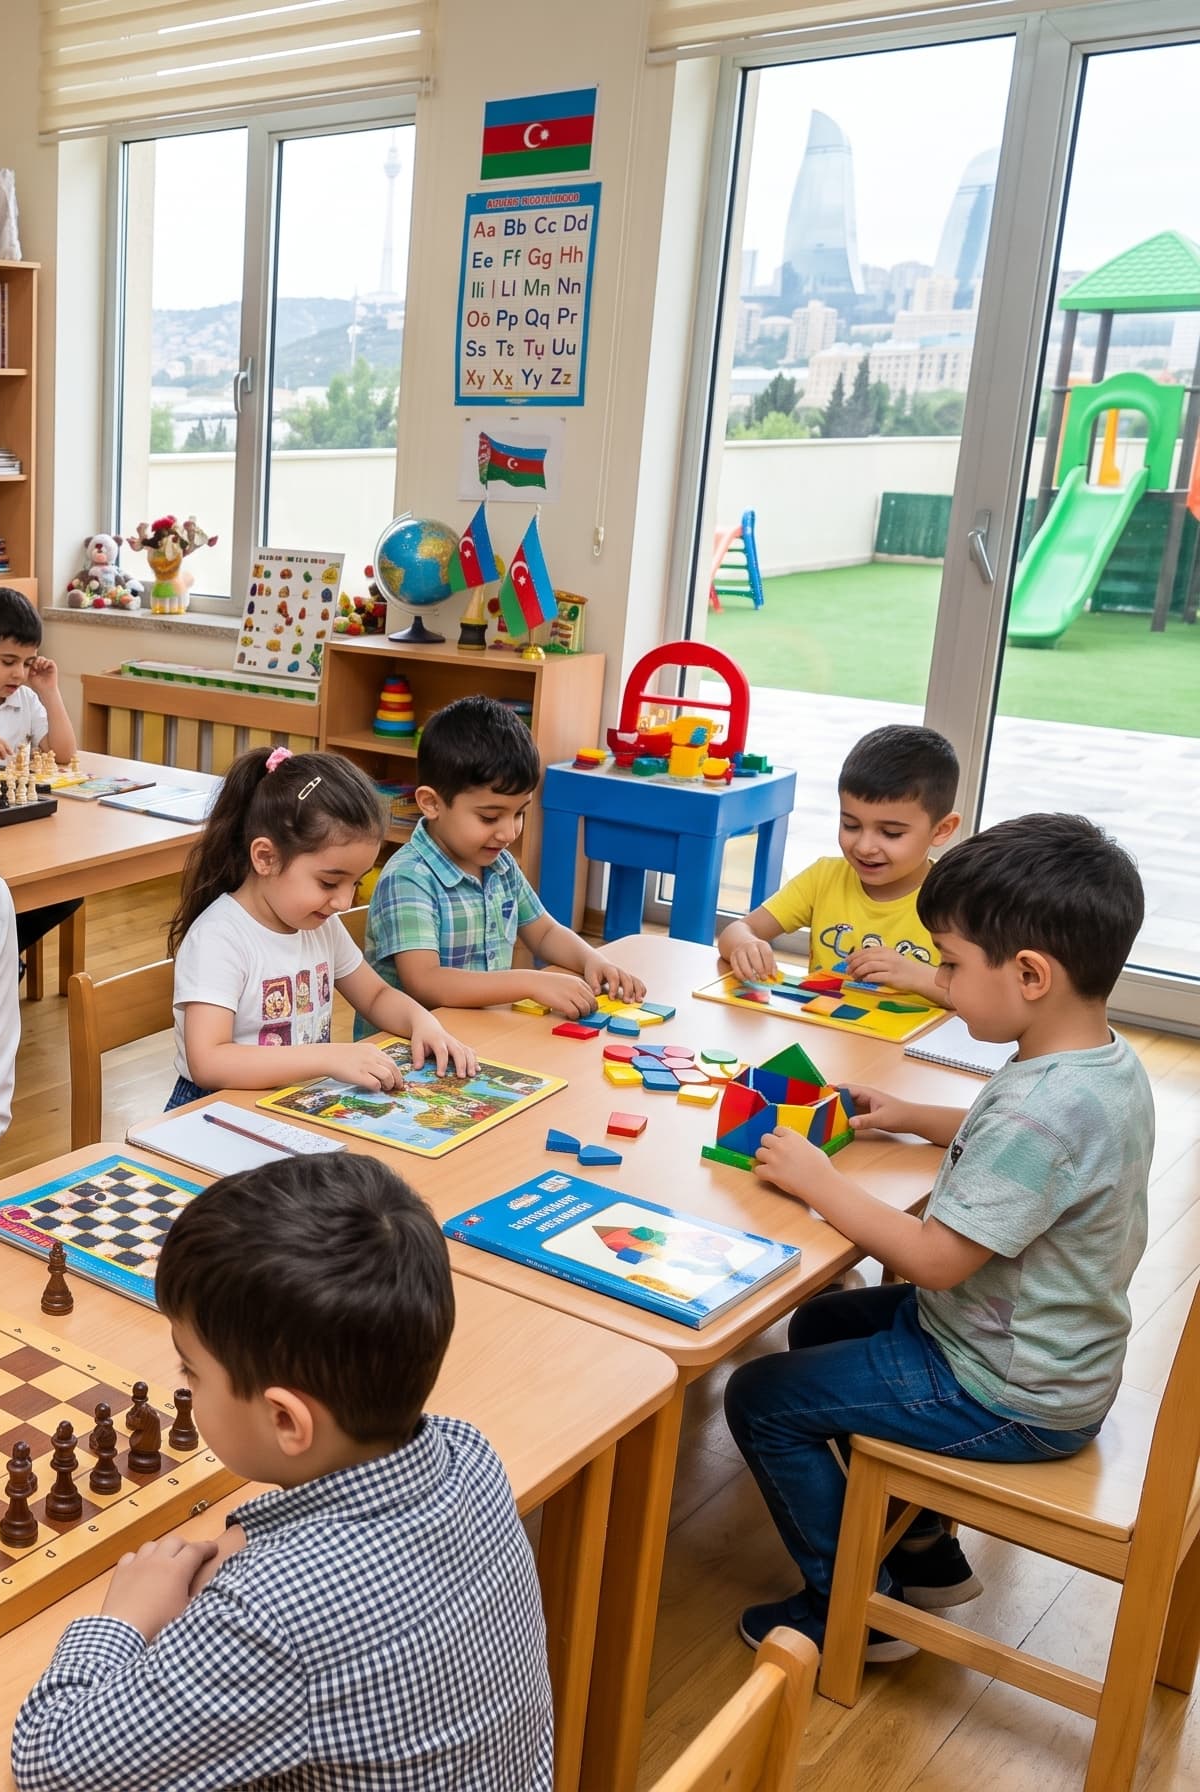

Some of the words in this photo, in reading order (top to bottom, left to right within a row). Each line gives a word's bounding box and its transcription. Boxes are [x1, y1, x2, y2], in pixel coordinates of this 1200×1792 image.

[473, 220, 496, 239] Aa
[503, 217, 527, 237] Bb
[534, 216, 557, 235] Cc
[563, 213, 589, 232] Dd
[471, 251, 494, 269] Ee
[503, 249, 522, 267] Ff
[527, 247, 553, 270] Gg
[560, 245, 584, 264] Hh
[557, 276, 582, 296] Nn
[496, 309, 519, 331] Pp
[524, 308, 550, 331] Qq
[557, 307, 579, 325] Pr
[465, 340, 487, 357] Ss
[552, 338, 577, 356] Uu
[466, 369, 486, 390] Xy
[521, 368, 543, 390] Yy
[550, 367, 572, 386] Zz
